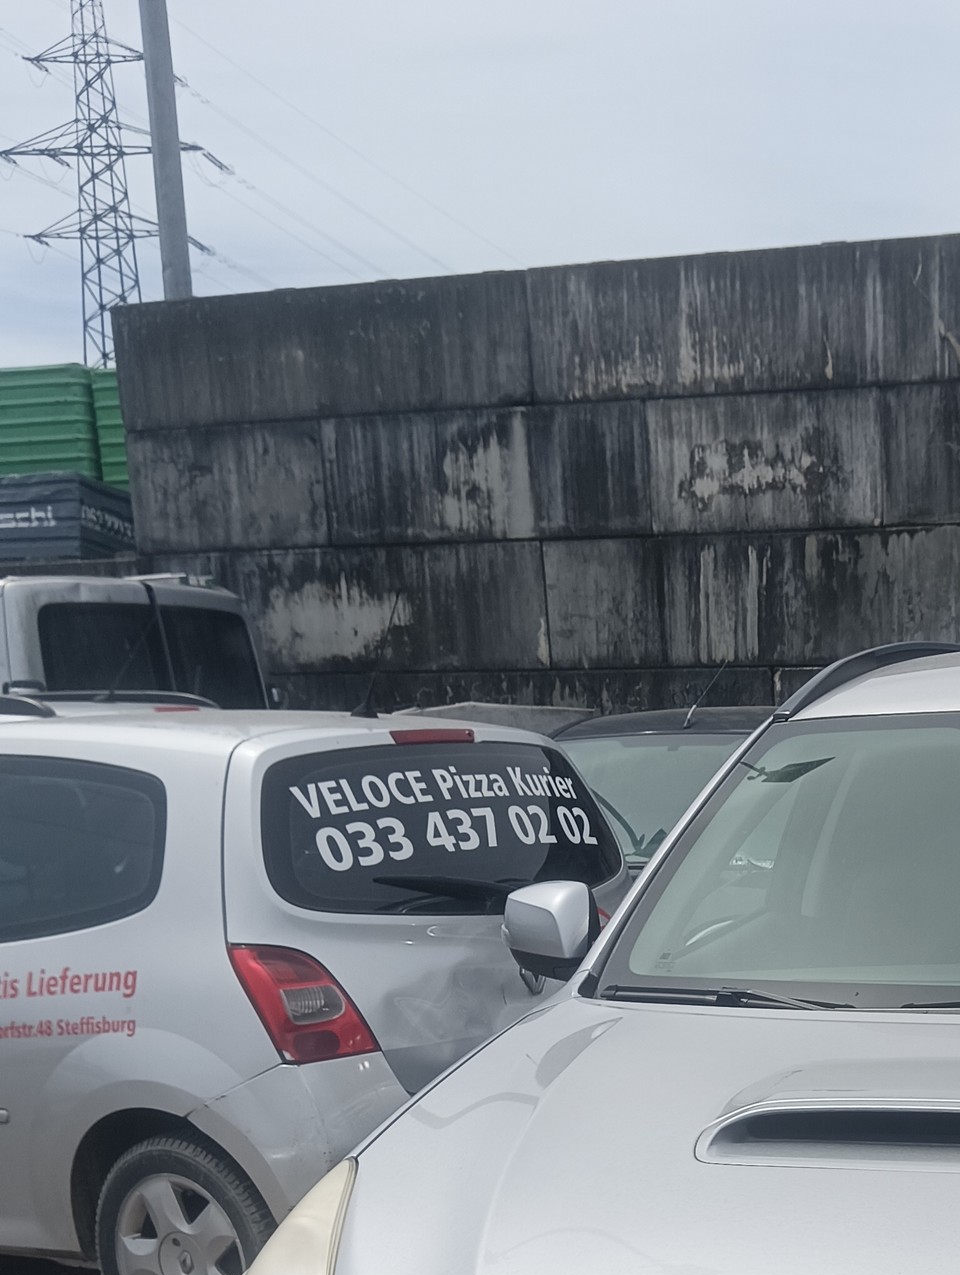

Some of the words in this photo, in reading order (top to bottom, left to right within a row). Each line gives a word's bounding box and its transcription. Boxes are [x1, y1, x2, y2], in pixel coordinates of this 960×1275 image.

[289, 770, 433, 819] VELOCE
[432, 765, 508, 801] Pizza
[506, 765, 577, 800] Kurier
[315, 817, 414, 872] 033
[425, 806, 499, 853] 437
[507, 805, 557, 845] 02
[556, 807, 598, 846] 02
[26, 966, 138, 999] Lieferung
[56, 1016, 136, 1038] Steffisburg
